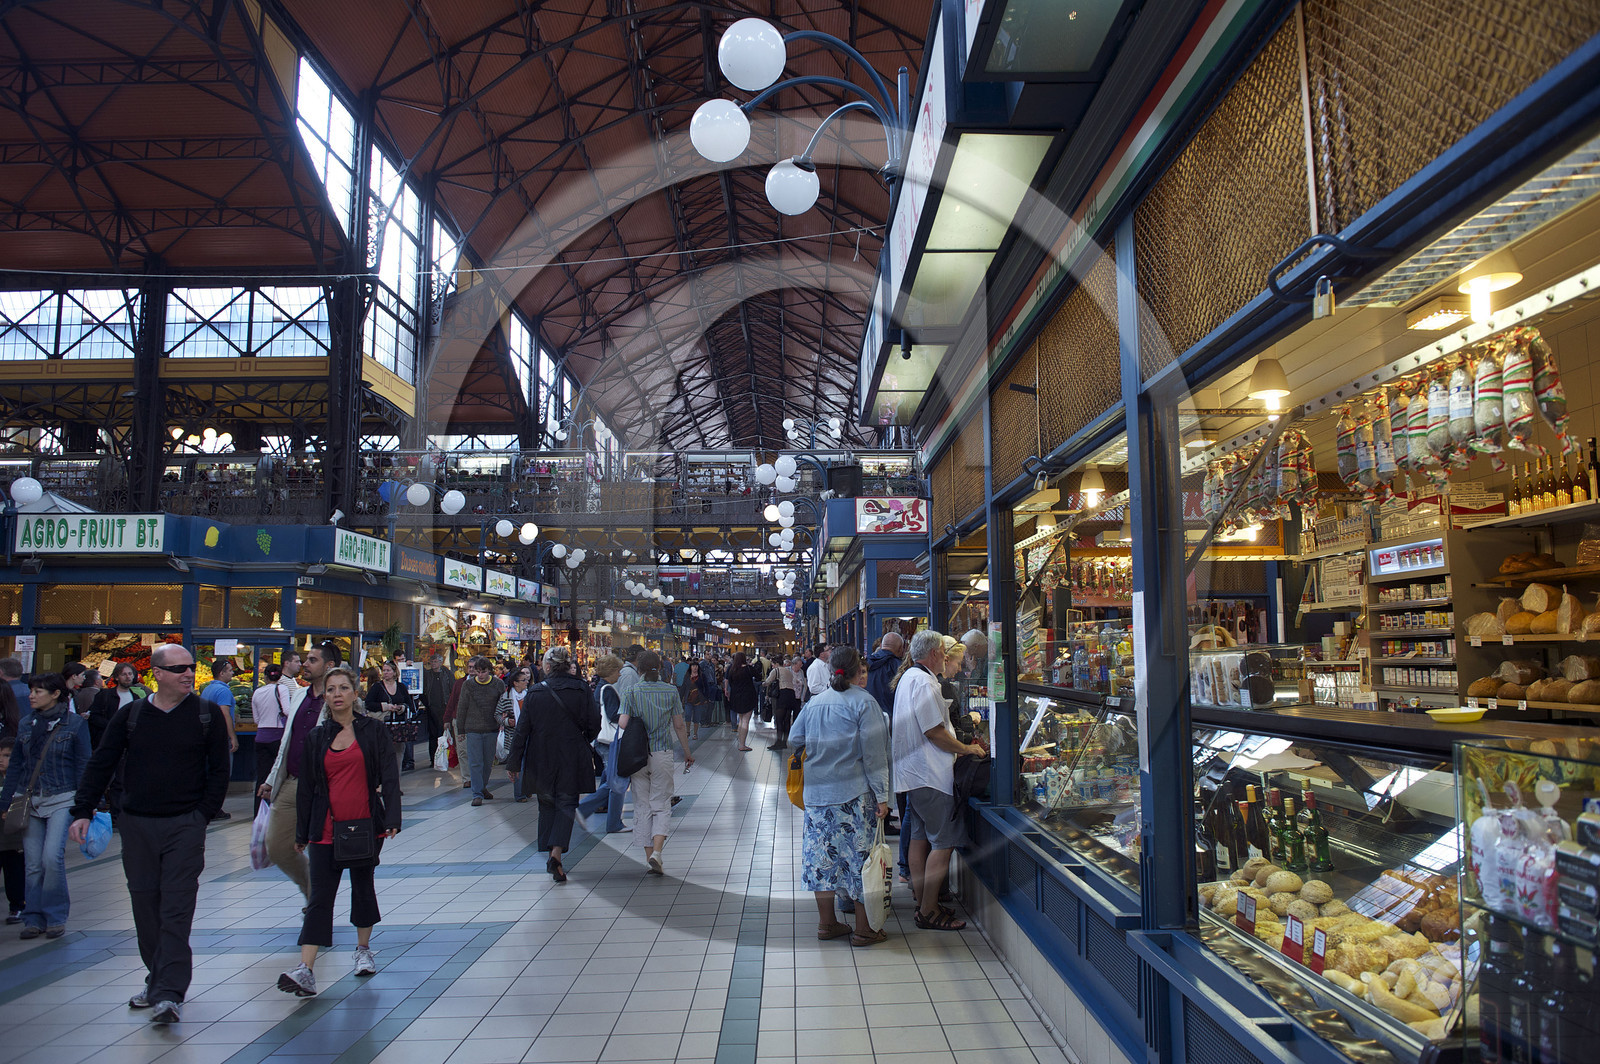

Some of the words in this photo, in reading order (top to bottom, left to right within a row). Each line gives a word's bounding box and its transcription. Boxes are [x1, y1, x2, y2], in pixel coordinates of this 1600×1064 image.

[20, 518, 127, 548] AGRO-FRUIT
[136, 518, 159, 548] BT.
[339, 533, 377, 566] AGRO-FRUIT
